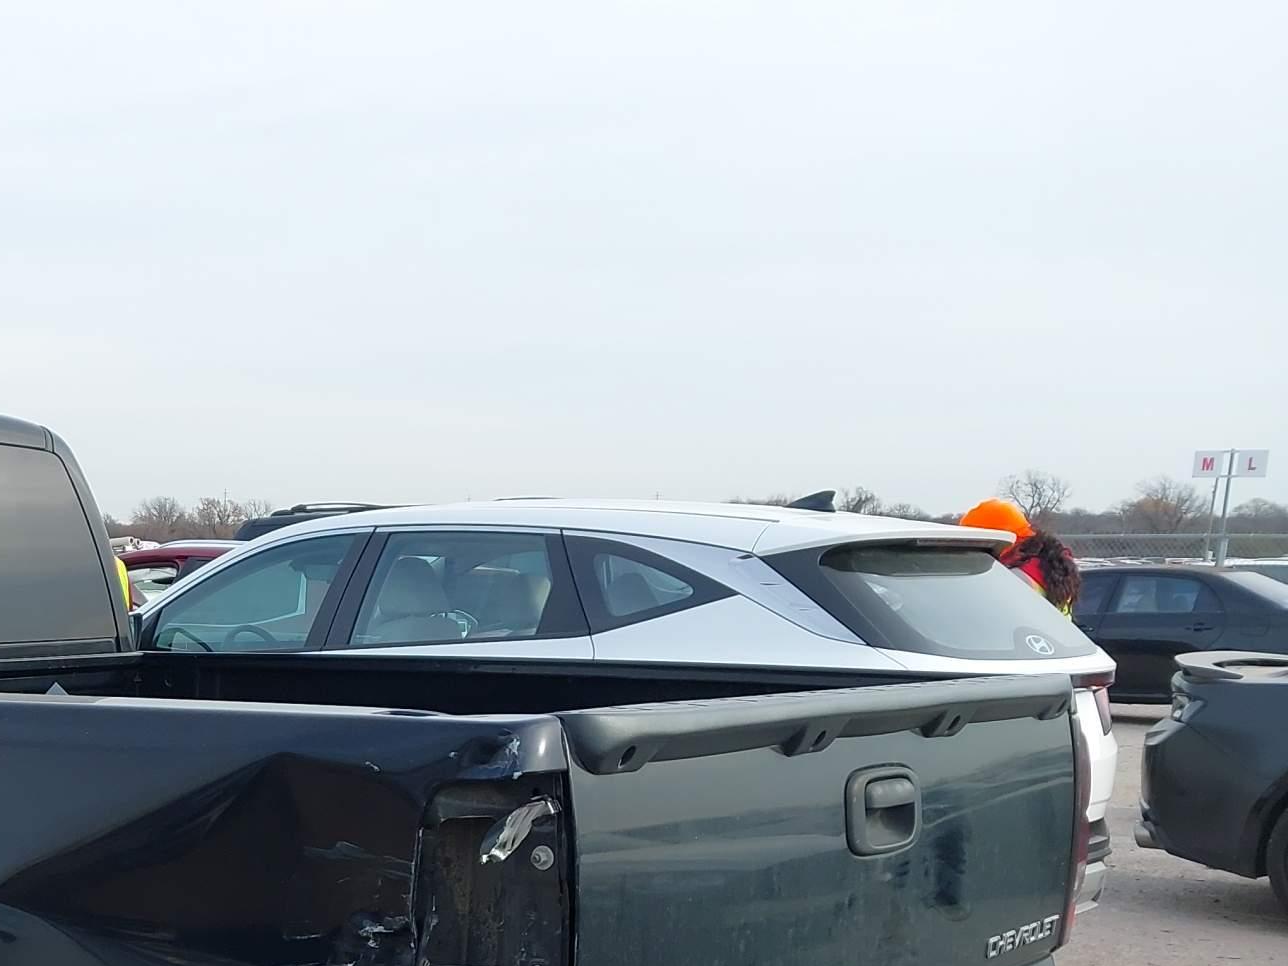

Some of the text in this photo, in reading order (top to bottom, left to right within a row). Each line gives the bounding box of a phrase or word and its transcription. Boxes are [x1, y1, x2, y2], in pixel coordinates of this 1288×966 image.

[1201, 456, 1215, 471] M
[1247, 456, 1257, 471] L
[984, 914, 1061, 959] CHEVROLET
